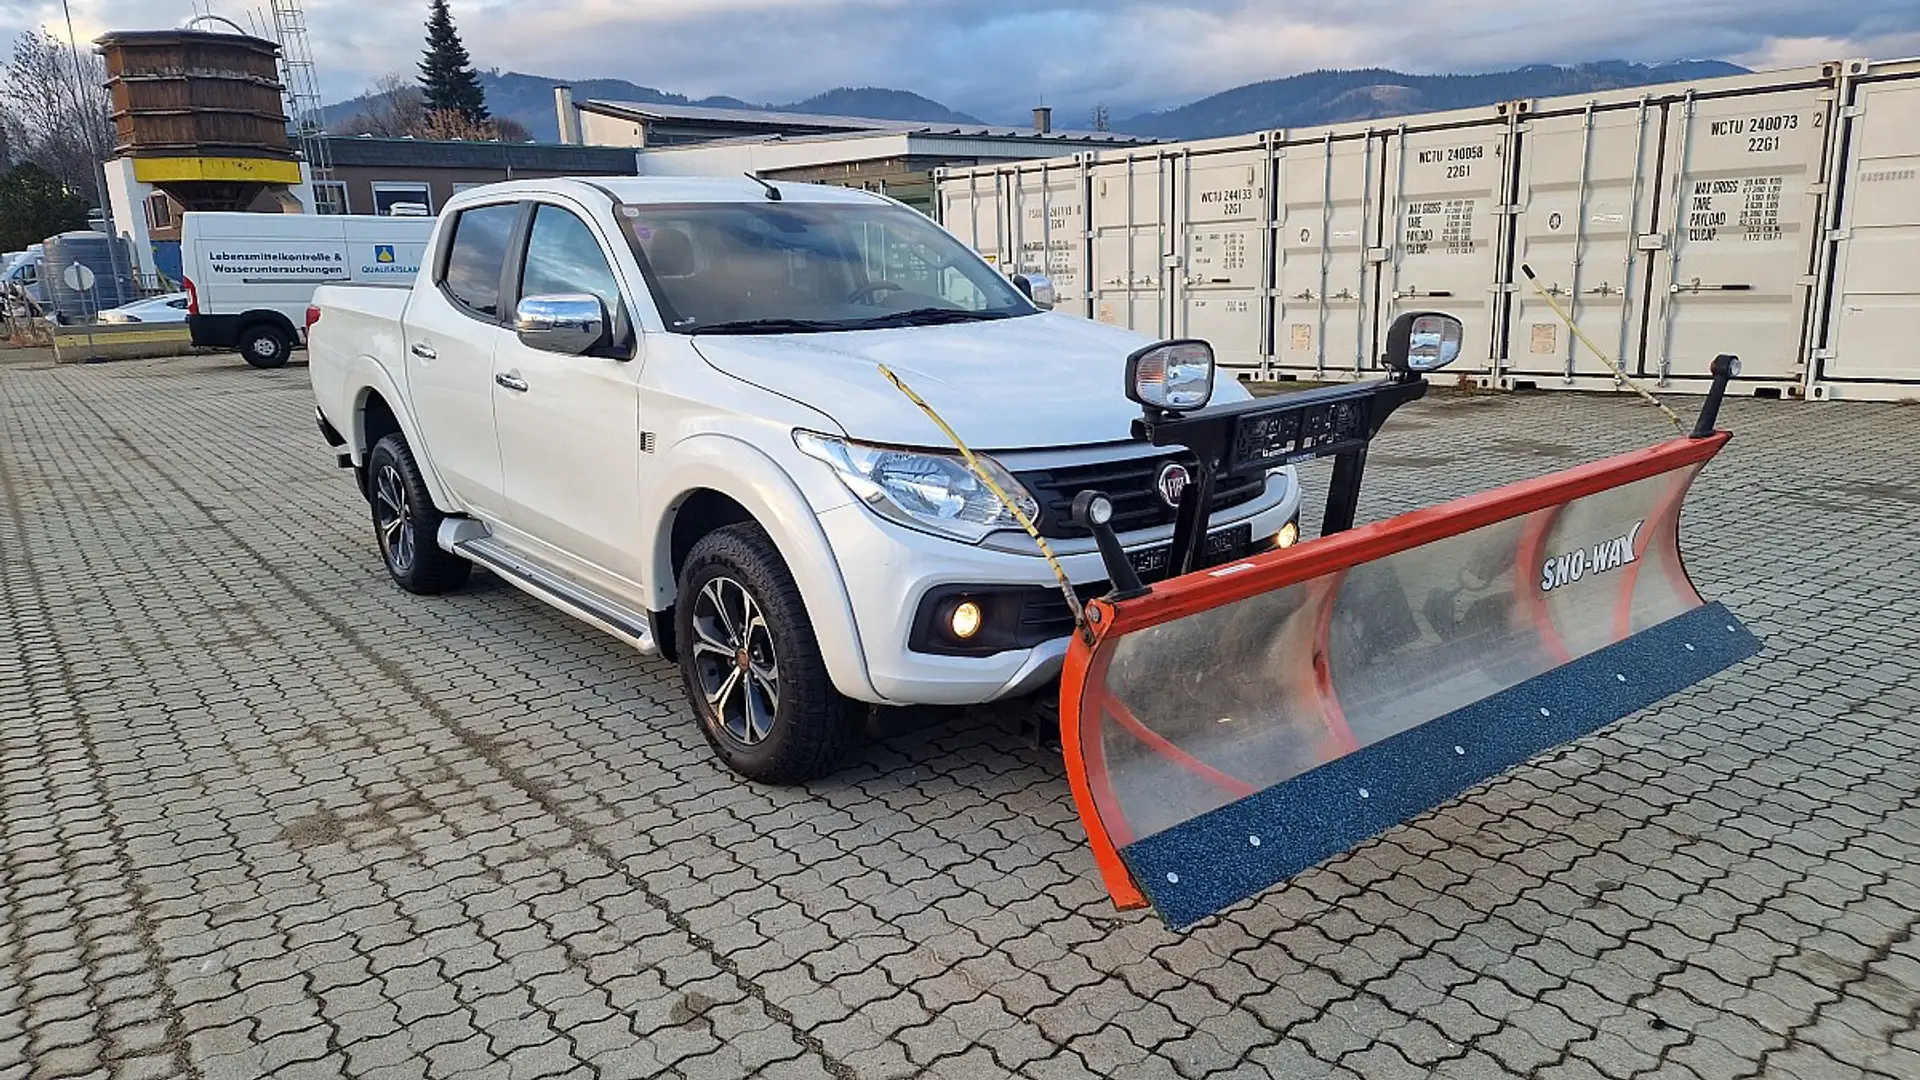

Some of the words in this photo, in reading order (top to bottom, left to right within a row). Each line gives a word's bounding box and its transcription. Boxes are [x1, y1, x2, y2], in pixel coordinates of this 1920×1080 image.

[1749, 114, 1798, 132] 240073
[1813, 112, 1823, 128] 2
[1747, 136, 1779, 152] 22G1
[1447, 145, 1483, 161] 240058
[209, 251, 331, 262] Lebensmittelkontrolle
[334, 253, 343, 262] &
[212, 264, 343, 275] Wasseruntersuchungen
[1540, 519, 1645, 592] SNO-WAY
